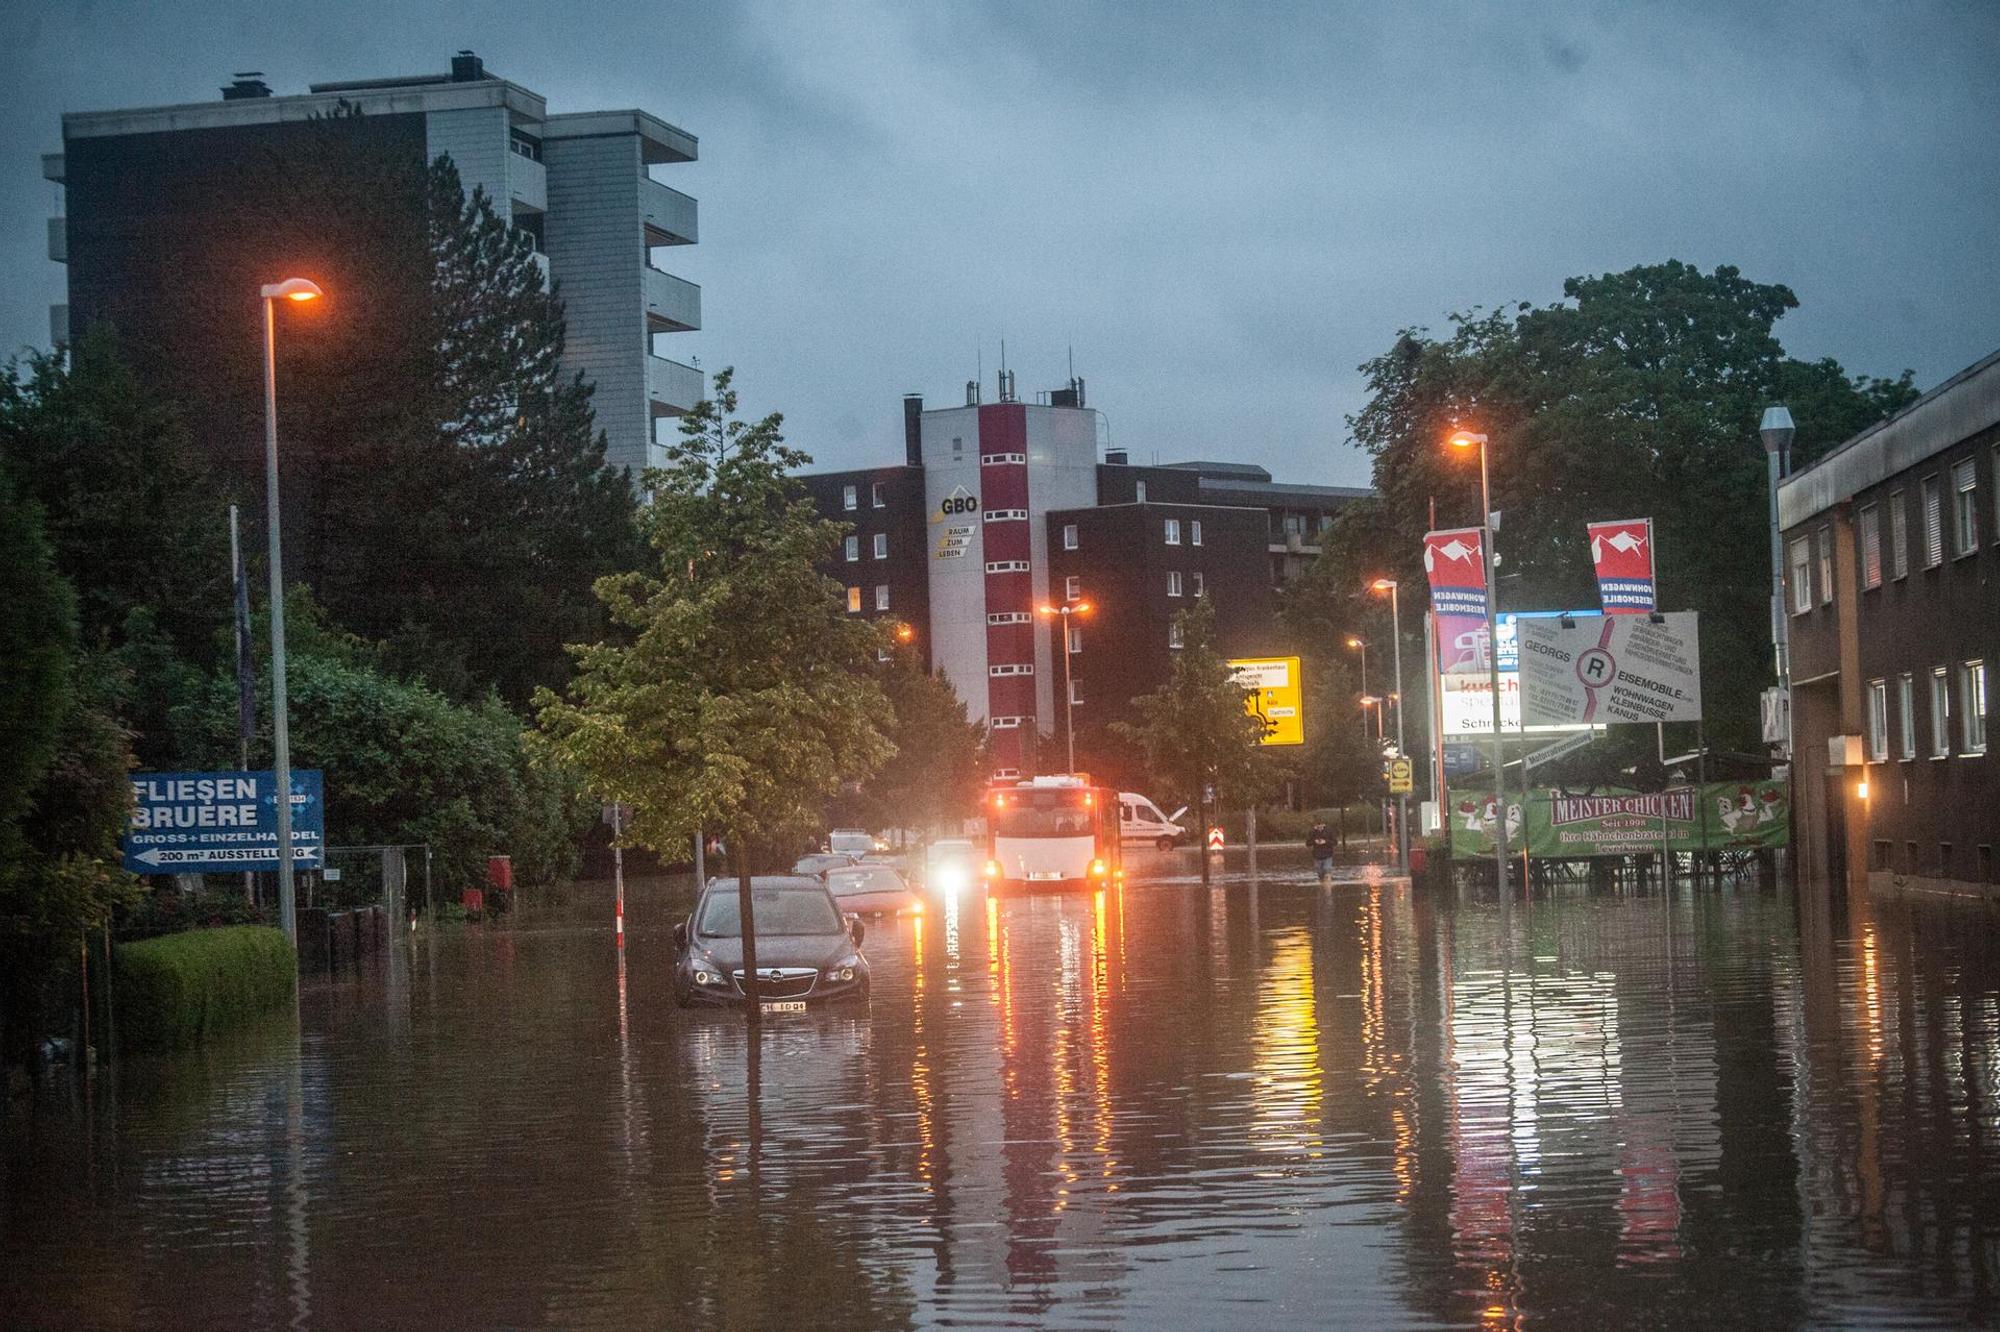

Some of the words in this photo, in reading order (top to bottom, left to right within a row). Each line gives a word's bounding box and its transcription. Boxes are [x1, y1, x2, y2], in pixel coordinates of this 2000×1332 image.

[942, 496, 977, 515] GBO
[949, 527, 970, 535] RAUM
[939, 549, 961, 557] LEBEN
[1524, 639, 1571, 663] GEORGS
[1586, 657, 1605, 678] R
[1617, 670, 1683, 700] EISEMOBILE
[1613, 685, 1674, 712] WOHNWAGEN
[1606, 705, 1639, 722] KANUS
[1609, 695, 1667, 721] KLEINBUSSE
[133, 778, 257, 801] FLIESEN
[1556, 798, 1621, 823] MEISTER
[1601, 819, 1620, 828] Seit
[132, 831, 320, 844] GROSS+EINZELHADEL
[159, 851, 183, 862] 200
[186, 851, 204, 861] m²
[208, 848, 305, 860] AUSSTELLG
